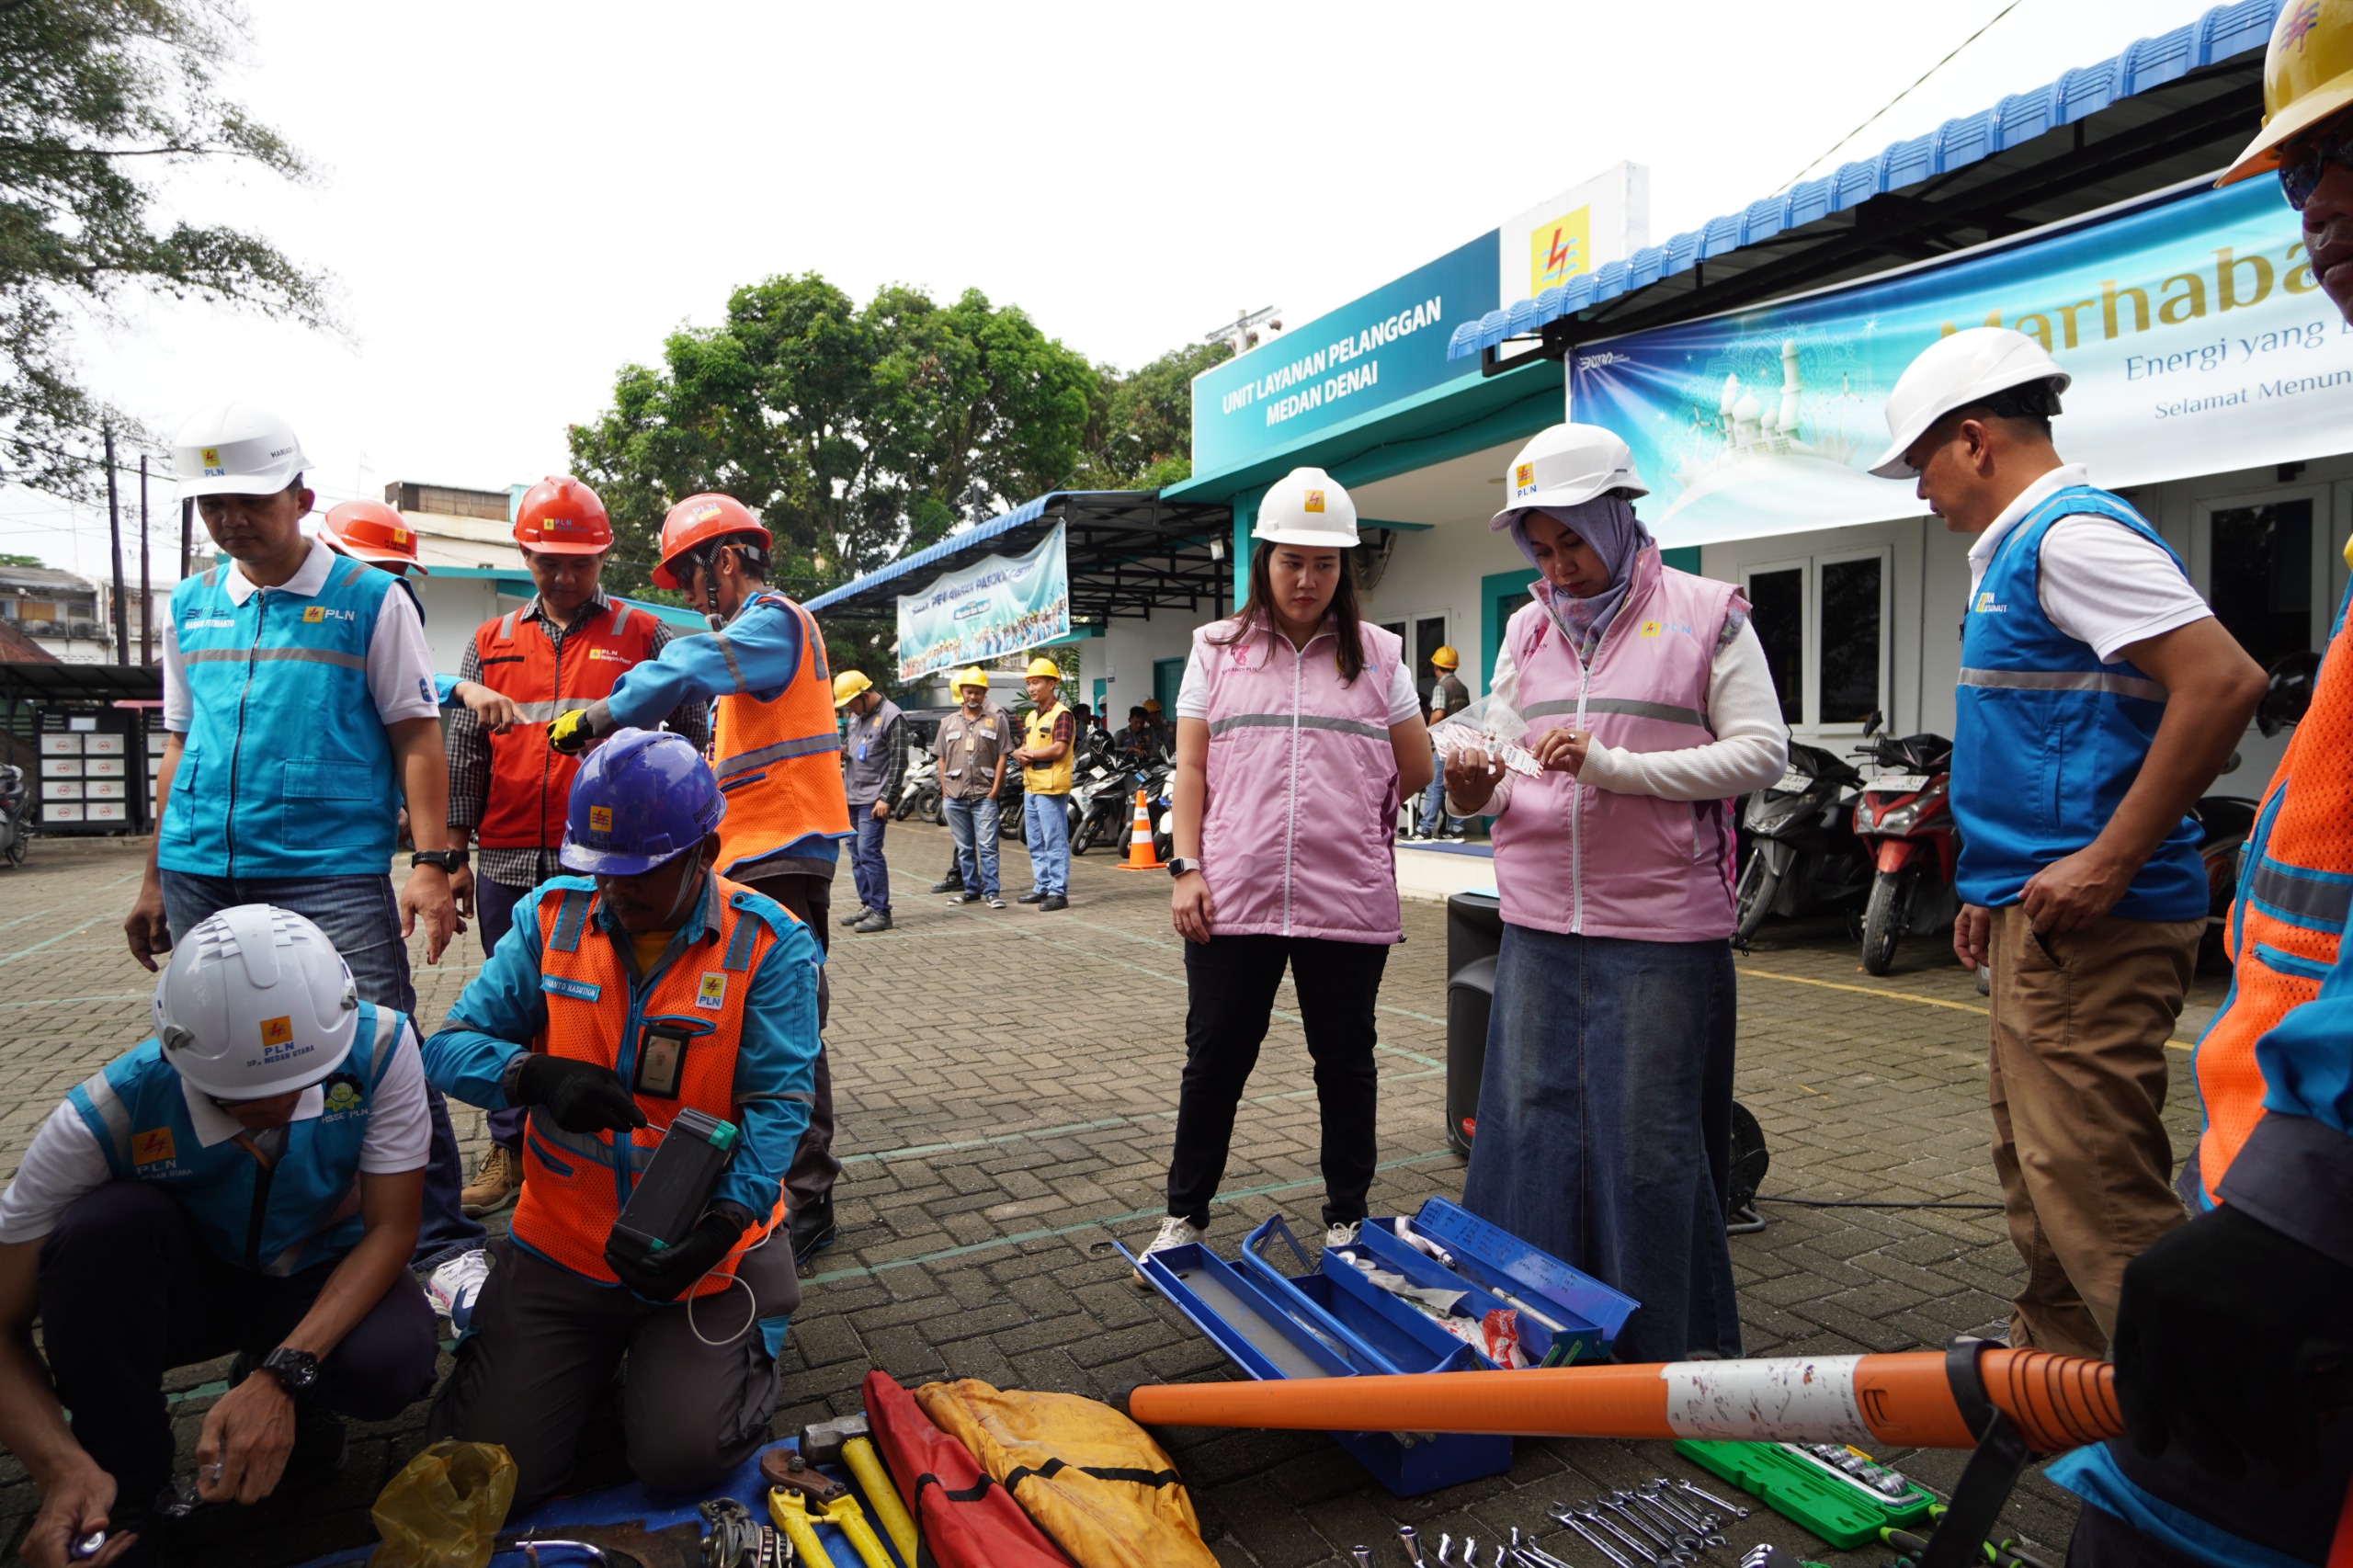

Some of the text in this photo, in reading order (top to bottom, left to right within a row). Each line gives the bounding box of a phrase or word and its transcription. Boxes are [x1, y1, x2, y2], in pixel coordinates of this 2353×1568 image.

[1222, 296, 1441, 415] UNIT LAYANAN PELANGGAN
[2125, 337, 2226, 381] Energi
[2239, 320, 2325, 364] yang
[1266, 360, 1378, 427] MEDAN DENAI
[2154, 387, 2249, 419] Selamat
[204, 468, 225, 477] PLN
[1518, 484, 1537, 498] PLN
[324, 609, 355, 621] PLN
[1661, 623, 1691, 634] PLN
[567, 985, 596, 997] NASUTION
[699, 995, 721, 1006] PLN
[264, 1041, 295, 1056] PLN
[264, 1052, 290, 1064] MEDAN
[292, 1045, 314, 1057] UTARA
[322, 1108, 369, 1124] HSSE PLN
[137, 1159, 177, 1175] PLN
